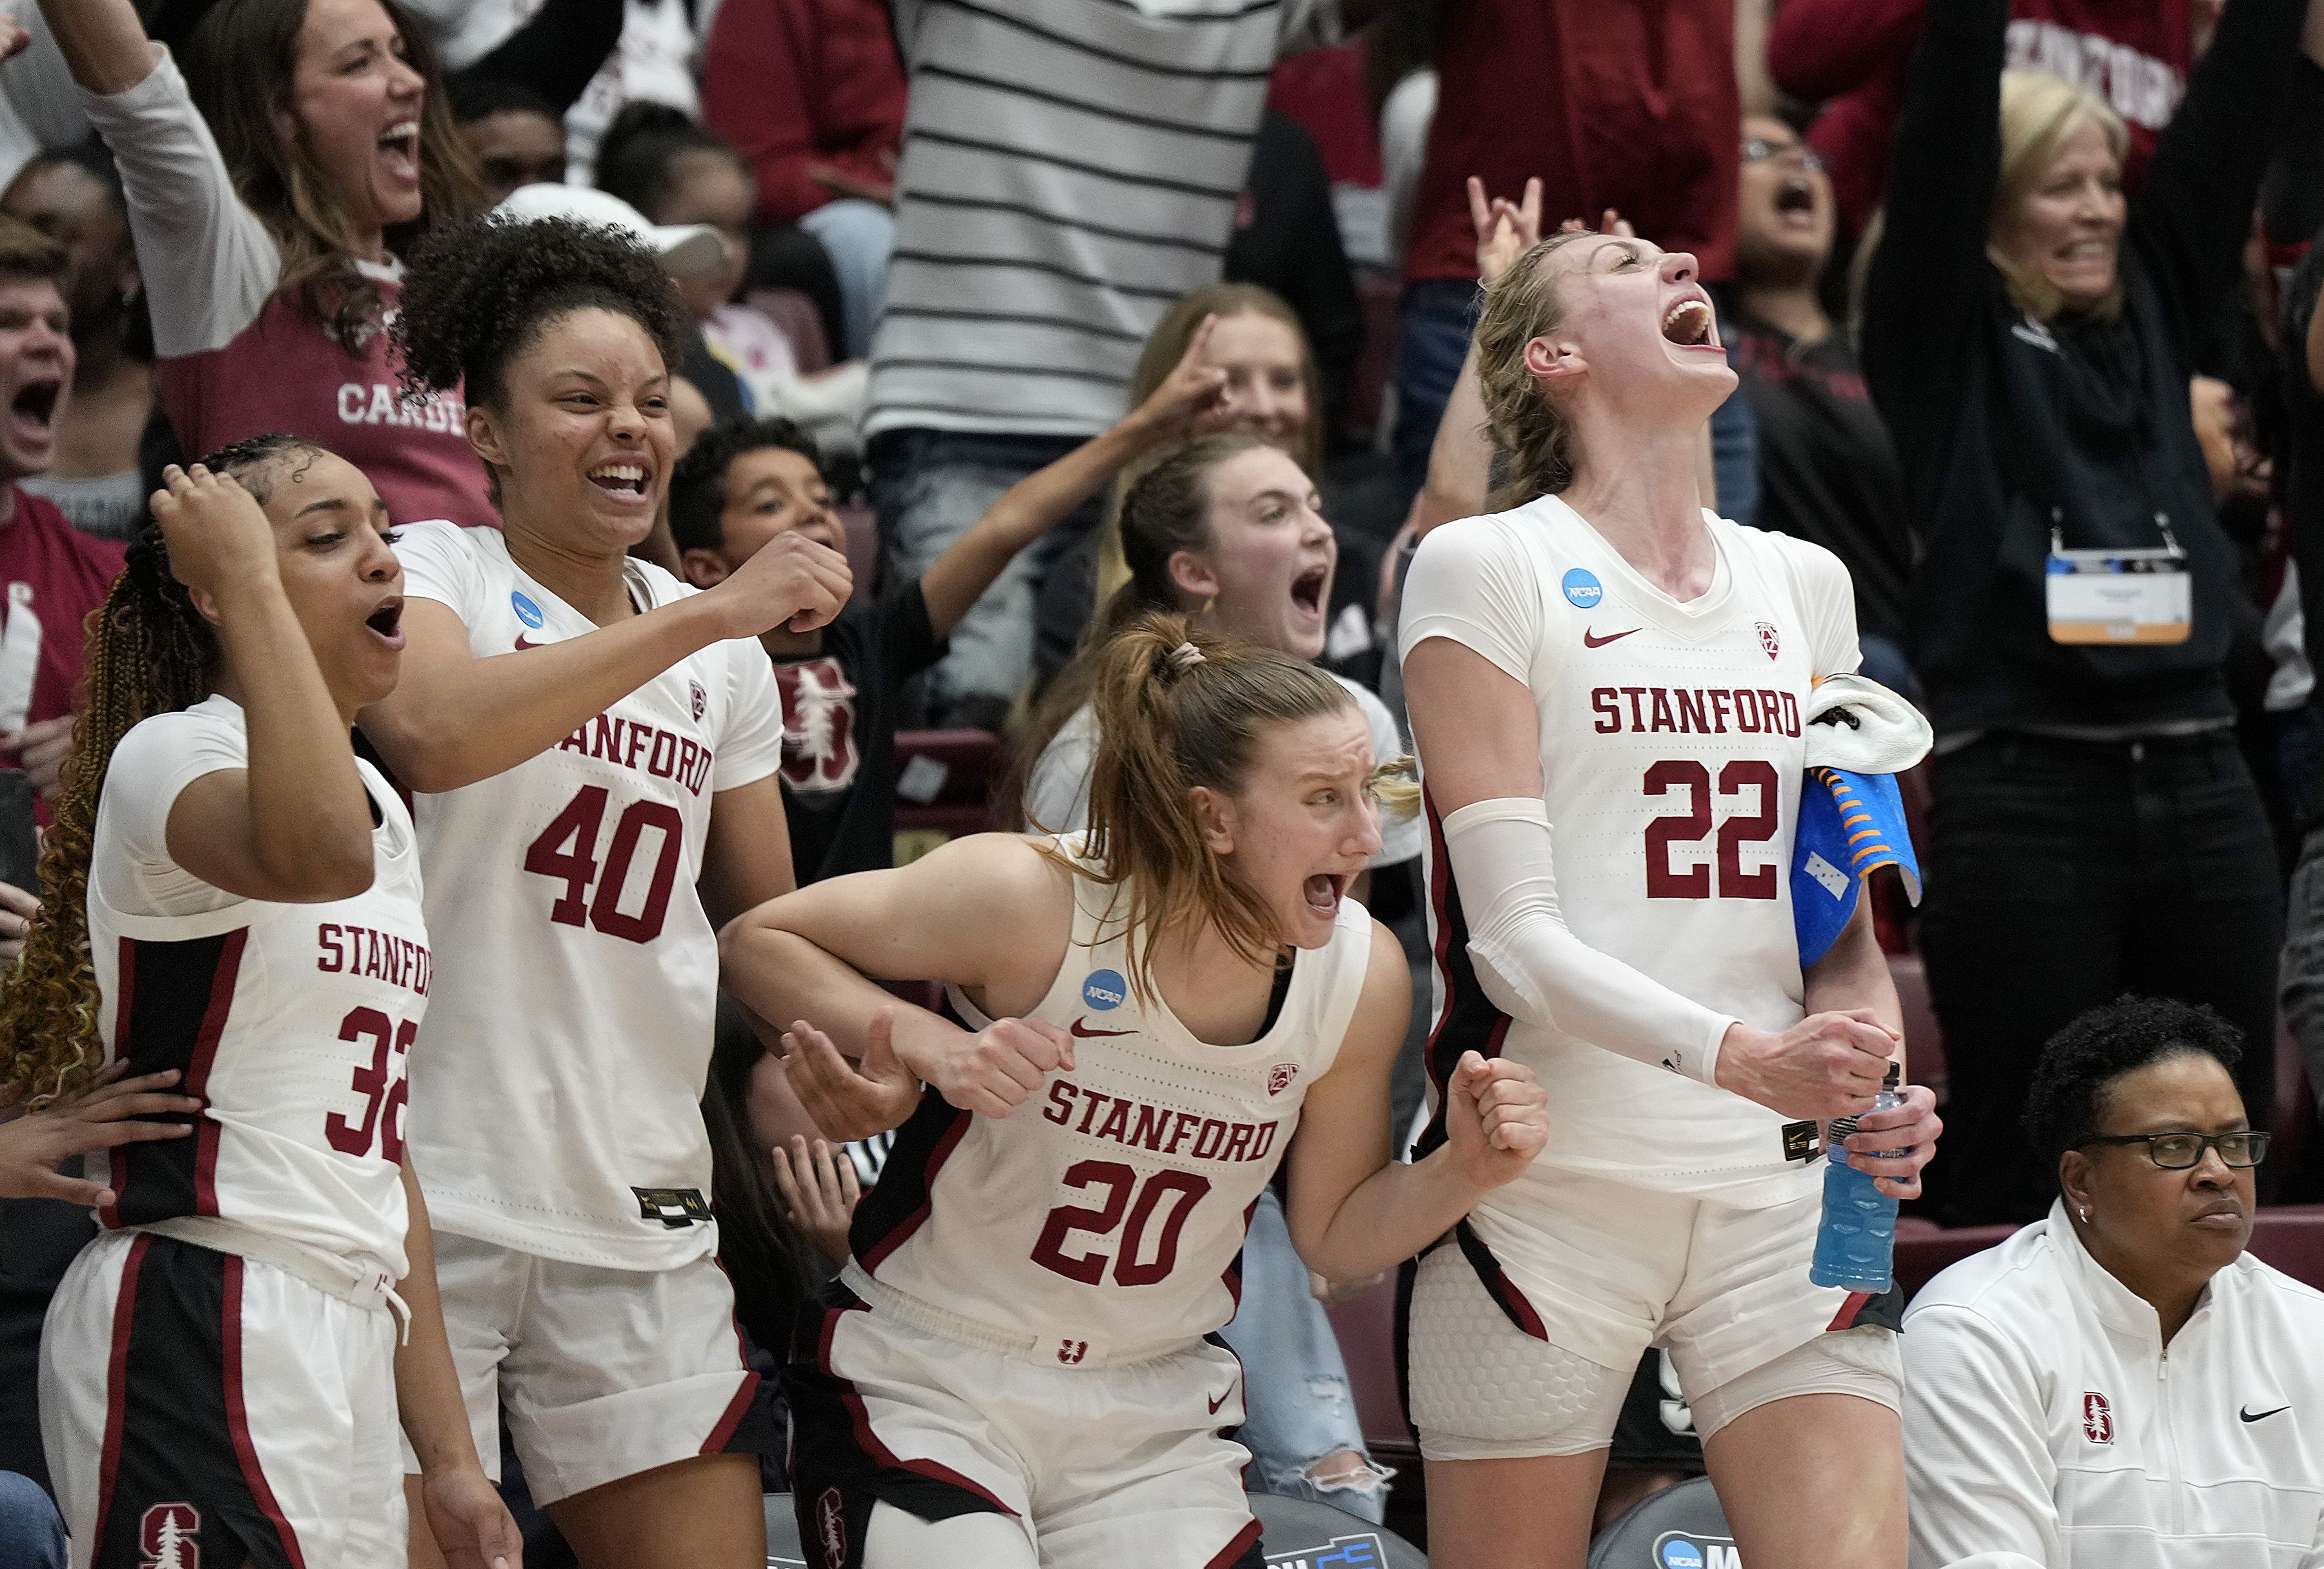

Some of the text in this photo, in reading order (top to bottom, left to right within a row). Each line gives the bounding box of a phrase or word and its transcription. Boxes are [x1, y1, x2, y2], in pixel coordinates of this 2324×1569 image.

[1569, 586, 1601, 597] NCAA
[1591, 687, 1801, 738] STANFORD
[559, 713, 713, 797] ANFORD
[524, 784, 683, 944] 40
[1644, 760, 1779, 900] 22
[317, 923, 433, 998] STANFO
[1043, 1080, 1279, 1162] STANFORD
[1030, 1160, 1212, 1287] 20
